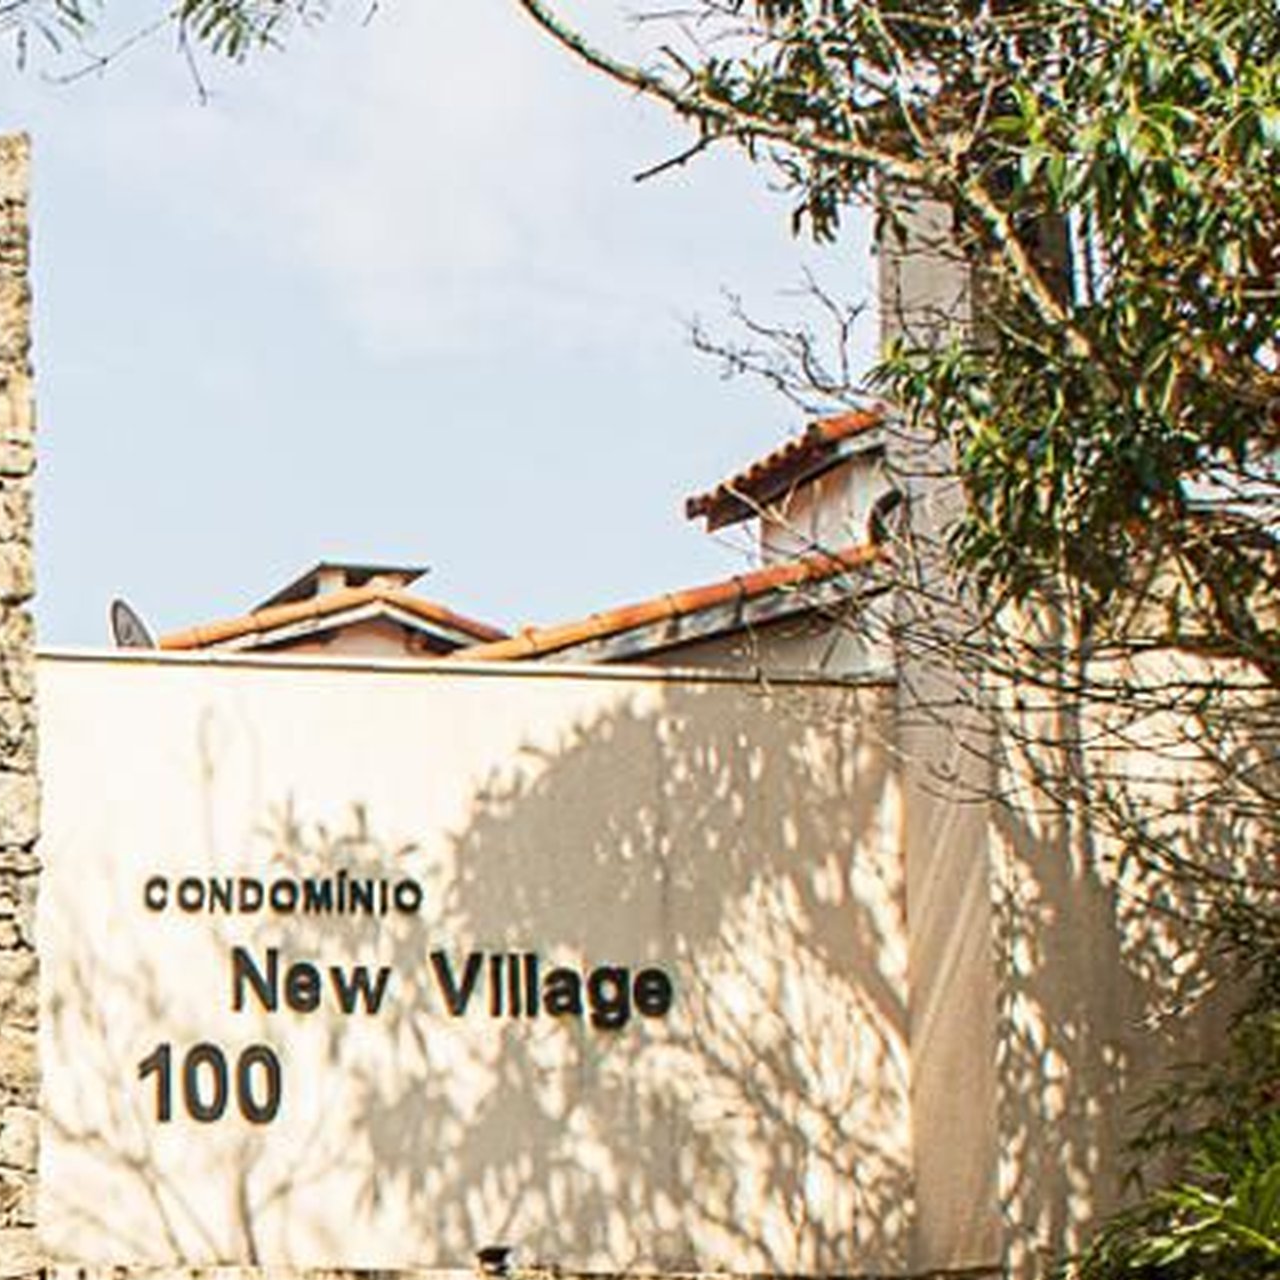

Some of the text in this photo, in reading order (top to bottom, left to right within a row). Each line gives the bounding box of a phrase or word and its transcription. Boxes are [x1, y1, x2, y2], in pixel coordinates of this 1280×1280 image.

[143, 869, 424, 916] CONDOMÍNIO
[230, 947, 674, 1030] New Village
[138, 1042, 282, 1124] 100
